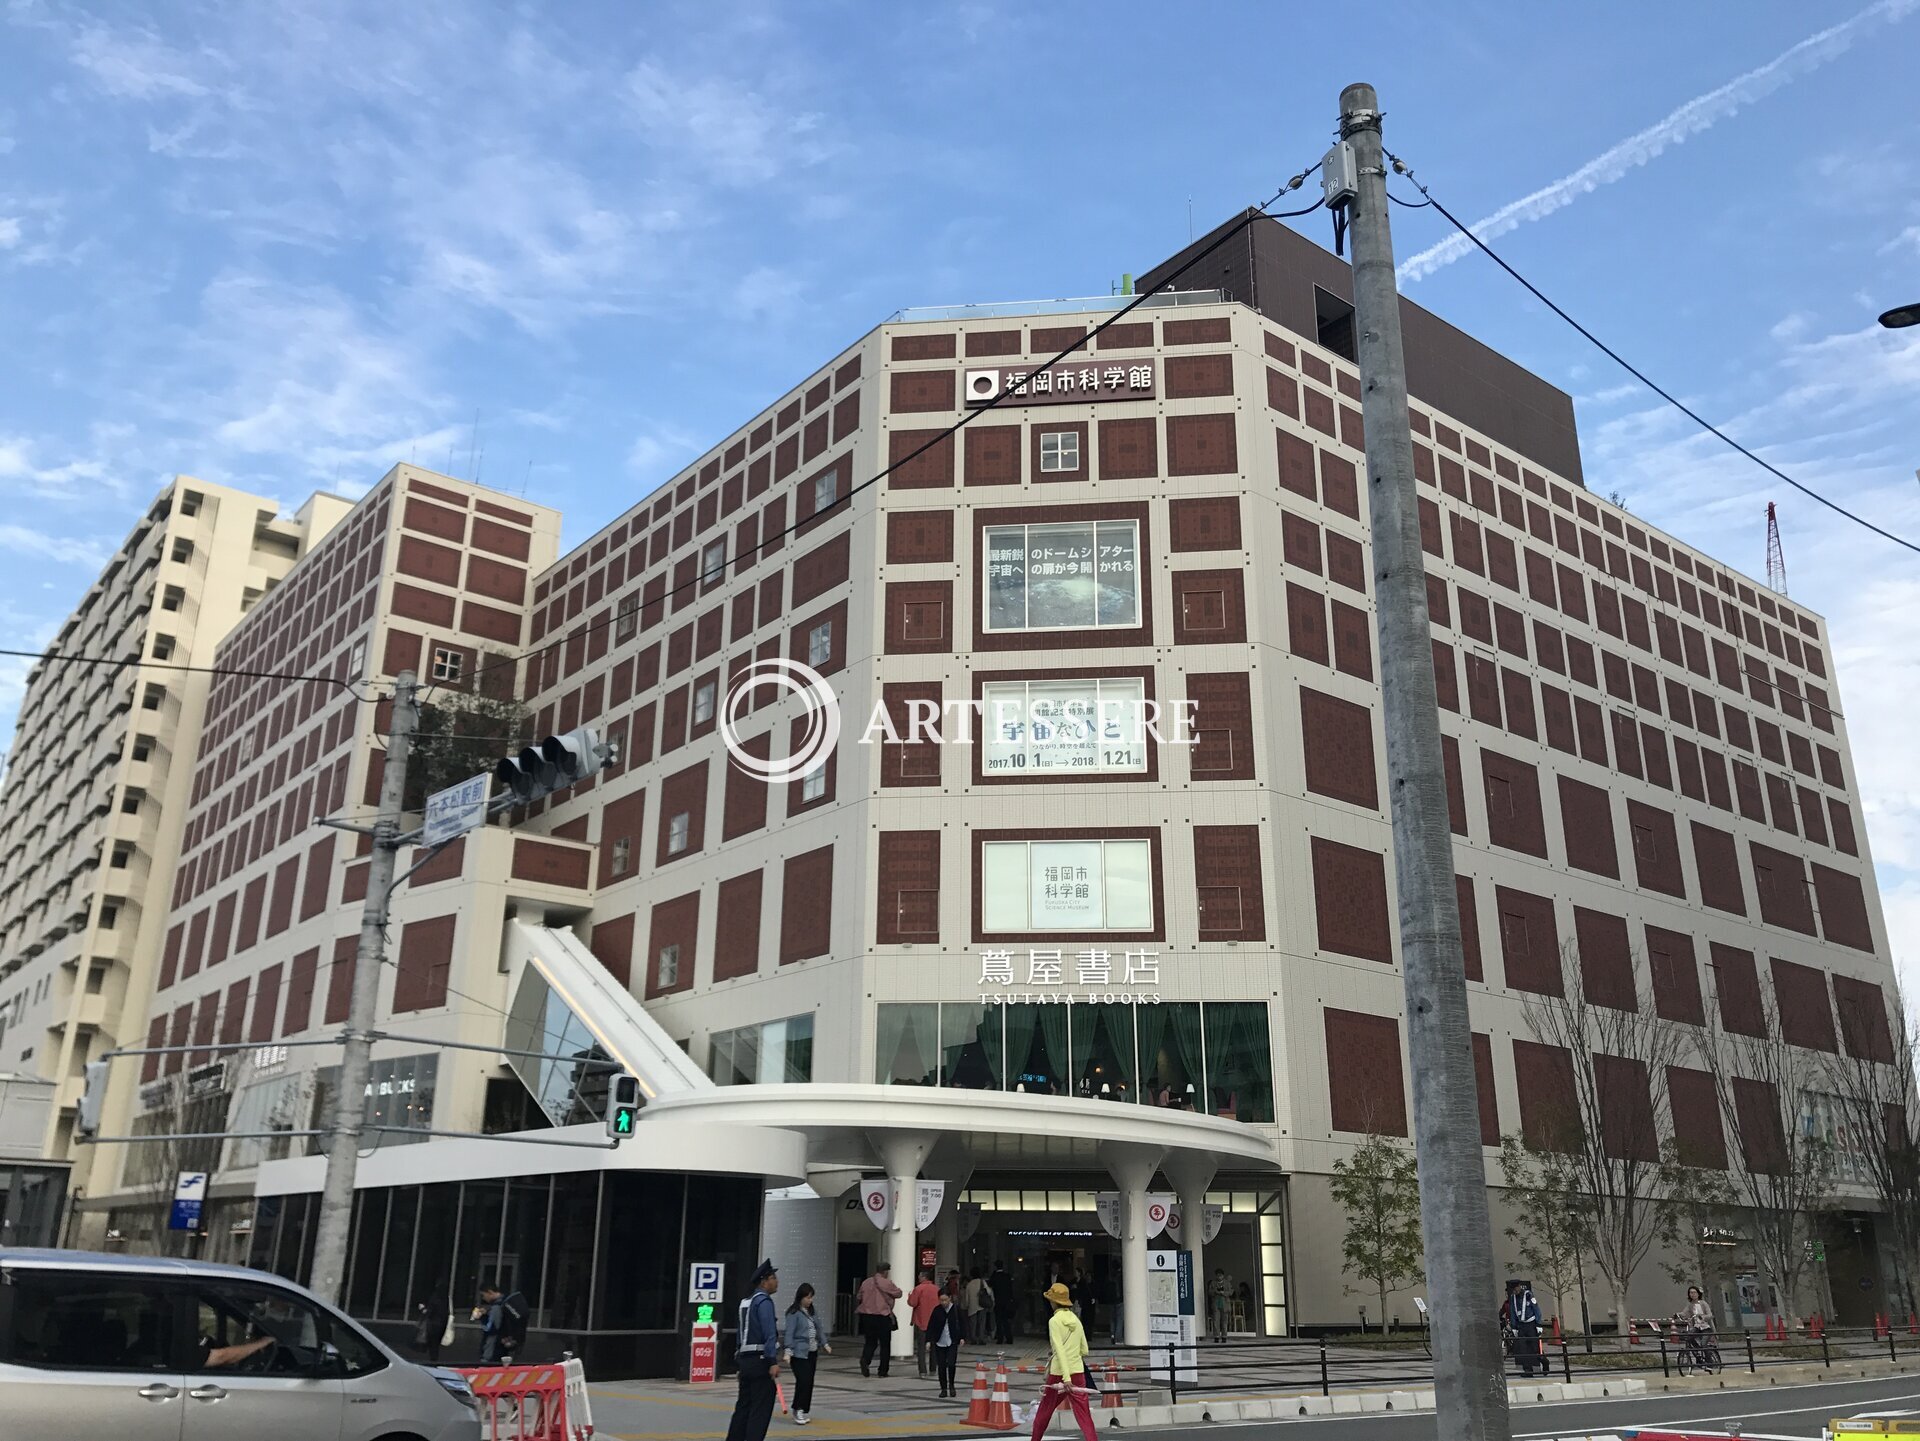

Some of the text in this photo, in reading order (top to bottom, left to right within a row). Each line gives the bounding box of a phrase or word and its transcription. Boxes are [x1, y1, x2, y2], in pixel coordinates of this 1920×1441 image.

[1004, 365, 1152, 395] 福岡市科学館
[1044, 866, 1088, 882] 福岡市
[1044, 883, 1090, 899] 科学館
[977, 948, 1160, 986] 蔦屋書店
[978, 992, 1161, 1006] TSUTAYA BOOKS
[698, 1269, 717, 1288] P
[695, 1291, 717, 1301] 入口
[697, 1304, 714, 1323] 空
